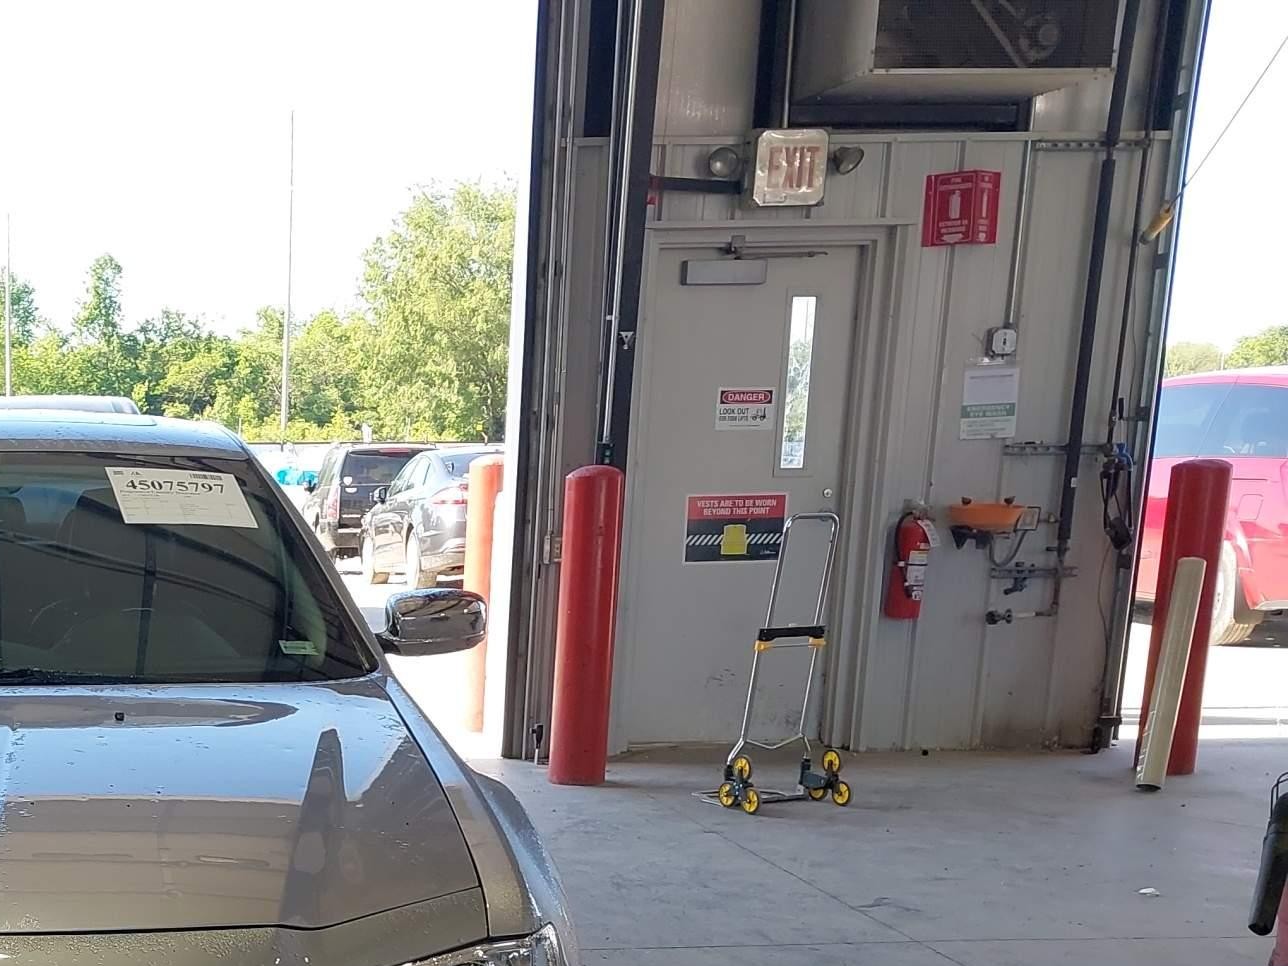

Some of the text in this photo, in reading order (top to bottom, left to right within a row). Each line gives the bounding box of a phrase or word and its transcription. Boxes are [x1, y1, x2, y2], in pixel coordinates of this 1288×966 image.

[766, 145, 821, 189] EXIT
[727, 393, 765, 401] DANGER
[719, 407, 749, 415] LOOK OUT
[125, 478, 225, 494] 45075797
[697, 498, 777, 508] VESTS ARE TO BE WORN
[703, 506, 771, 516] BEYOND THIS POINT
